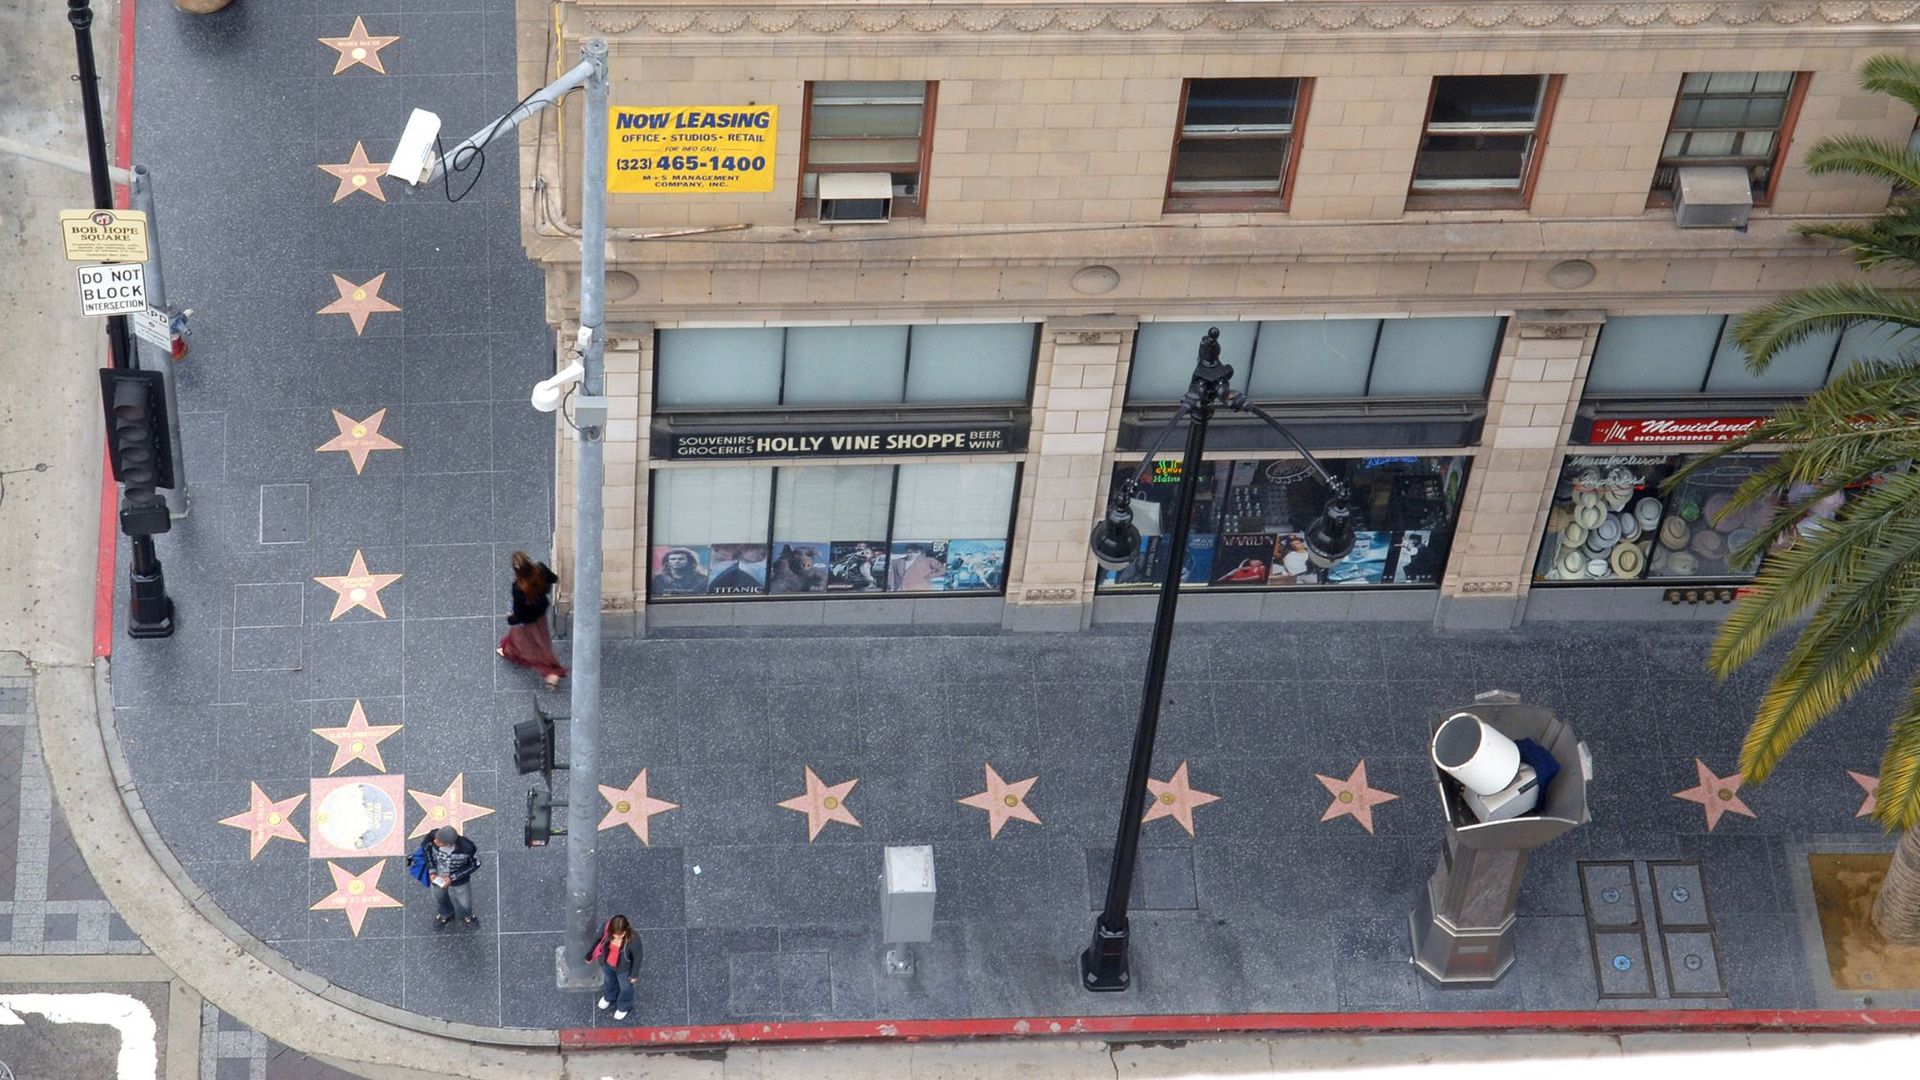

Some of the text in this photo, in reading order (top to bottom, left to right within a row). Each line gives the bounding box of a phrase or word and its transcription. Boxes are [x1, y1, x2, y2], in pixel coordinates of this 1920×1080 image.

[616, 112, 770, 129] NOW LEASING
[622, 133, 765, 142] OFFICE STUDIOS RETAIL
[617, 155, 766, 171] (323) 465-1400
[103, 227, 139, 235] HOPE
[82, 269, 140, 285] DO NOT
[84, 286, 143, 301] BLOCK
[86, 300, 144, 312] INTERSECTION
[1641, 420, 1757, 433] Movieland
[679, 436, 755, 446] SOUVENIRS
[969, 431, 1001, 440] BEER
[757, 433, 966, 452] HOLLY VINE SHOPPE
[968, 440, 1003, 449] WINE
[677, 446, 754, 455] GROCERIES
[715, 586, 763, 594] TITANIC
